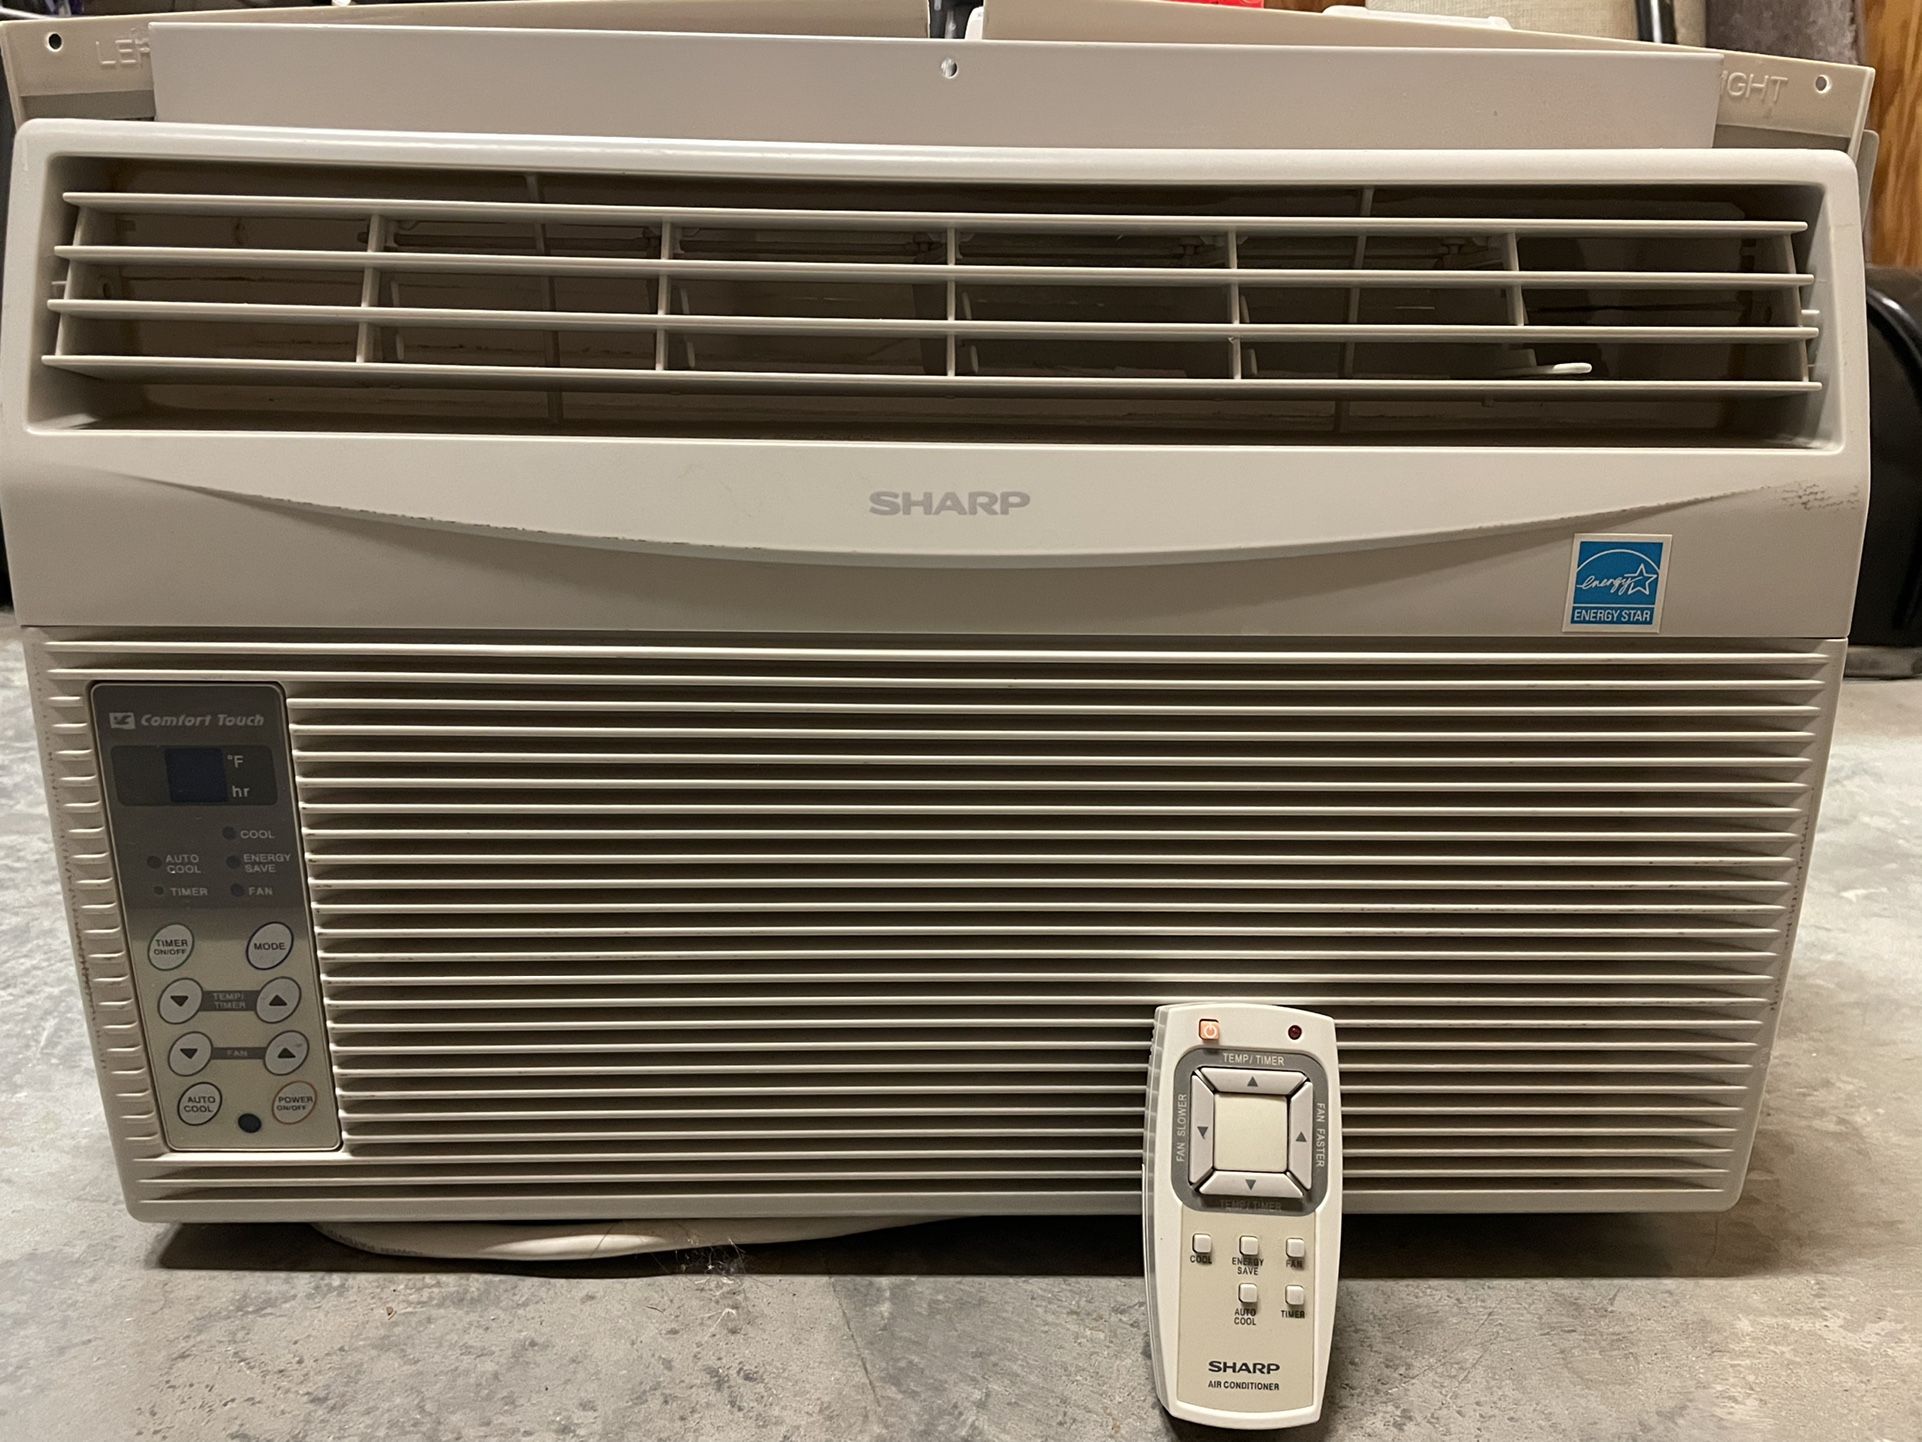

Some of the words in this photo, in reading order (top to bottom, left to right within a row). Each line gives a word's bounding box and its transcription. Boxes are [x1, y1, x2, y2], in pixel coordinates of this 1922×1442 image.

[95, 36, 151, 68] LEF
[1720, 69, 1789, 102] IGHT
[868, 490, 1031, 516] SHARP
[1573, 609, 1620, 621] ENERGY
[1621, 609, 1651, 622] STAR
[140, 713, 212, 727] Comfort
[217, 713, 265, 726] Touch
[231, 785, 251, 798] hr
[240, 829, 275, 839] COOL
[165, 853, 200, 864] AUTO
[243, 853, 291, 863] ENERGY
[167, 864, 201, 874] COOL
[244, 864, 276, 873] SAVE
[170, 887, 208, 896] TIMER
[248, 887, 273, 896] FAN
[155, 938, 188, 948] TIMER
[253, 942, 287, 951] MODE
[153, 948, 187, 956] ON/OFF
[214, 1001, 246, 1009] TIMER
[1256, 1055, 1285, 1066] TIMER
[187, 1096, 216, 1104] AUTO
[278, 1096, 313, 1104] POWER
[183, 1105, 214, 1113] COOL
[1316, 1102, 1326, 1123] FAN
[1177, 1093, 1188, 1137] SLOWER
[1176, 1140, 1185, 1162] FAN
[1315, 1128, 1326, 1168] FASTER
[1190, 1255, 1212, 1264] COOL
[1232, 1257, 1264, 1267] ENERGY
[1286, 1259, 1304, 1268] FAN
[1237, 1266, 1259, 1275] SAVE
[1234, 1308, 1257, 1316] AUTO
[1281, 1310, 1305, 1319] TIMER
[1234, 1317, 1257, 1326] COOL
[1208, 1360, 1281, 1375] SHARP
[1208, 1380, 1222, 1389] AIR
[1223, 1381, 1280, 1391] CONDITIONER
